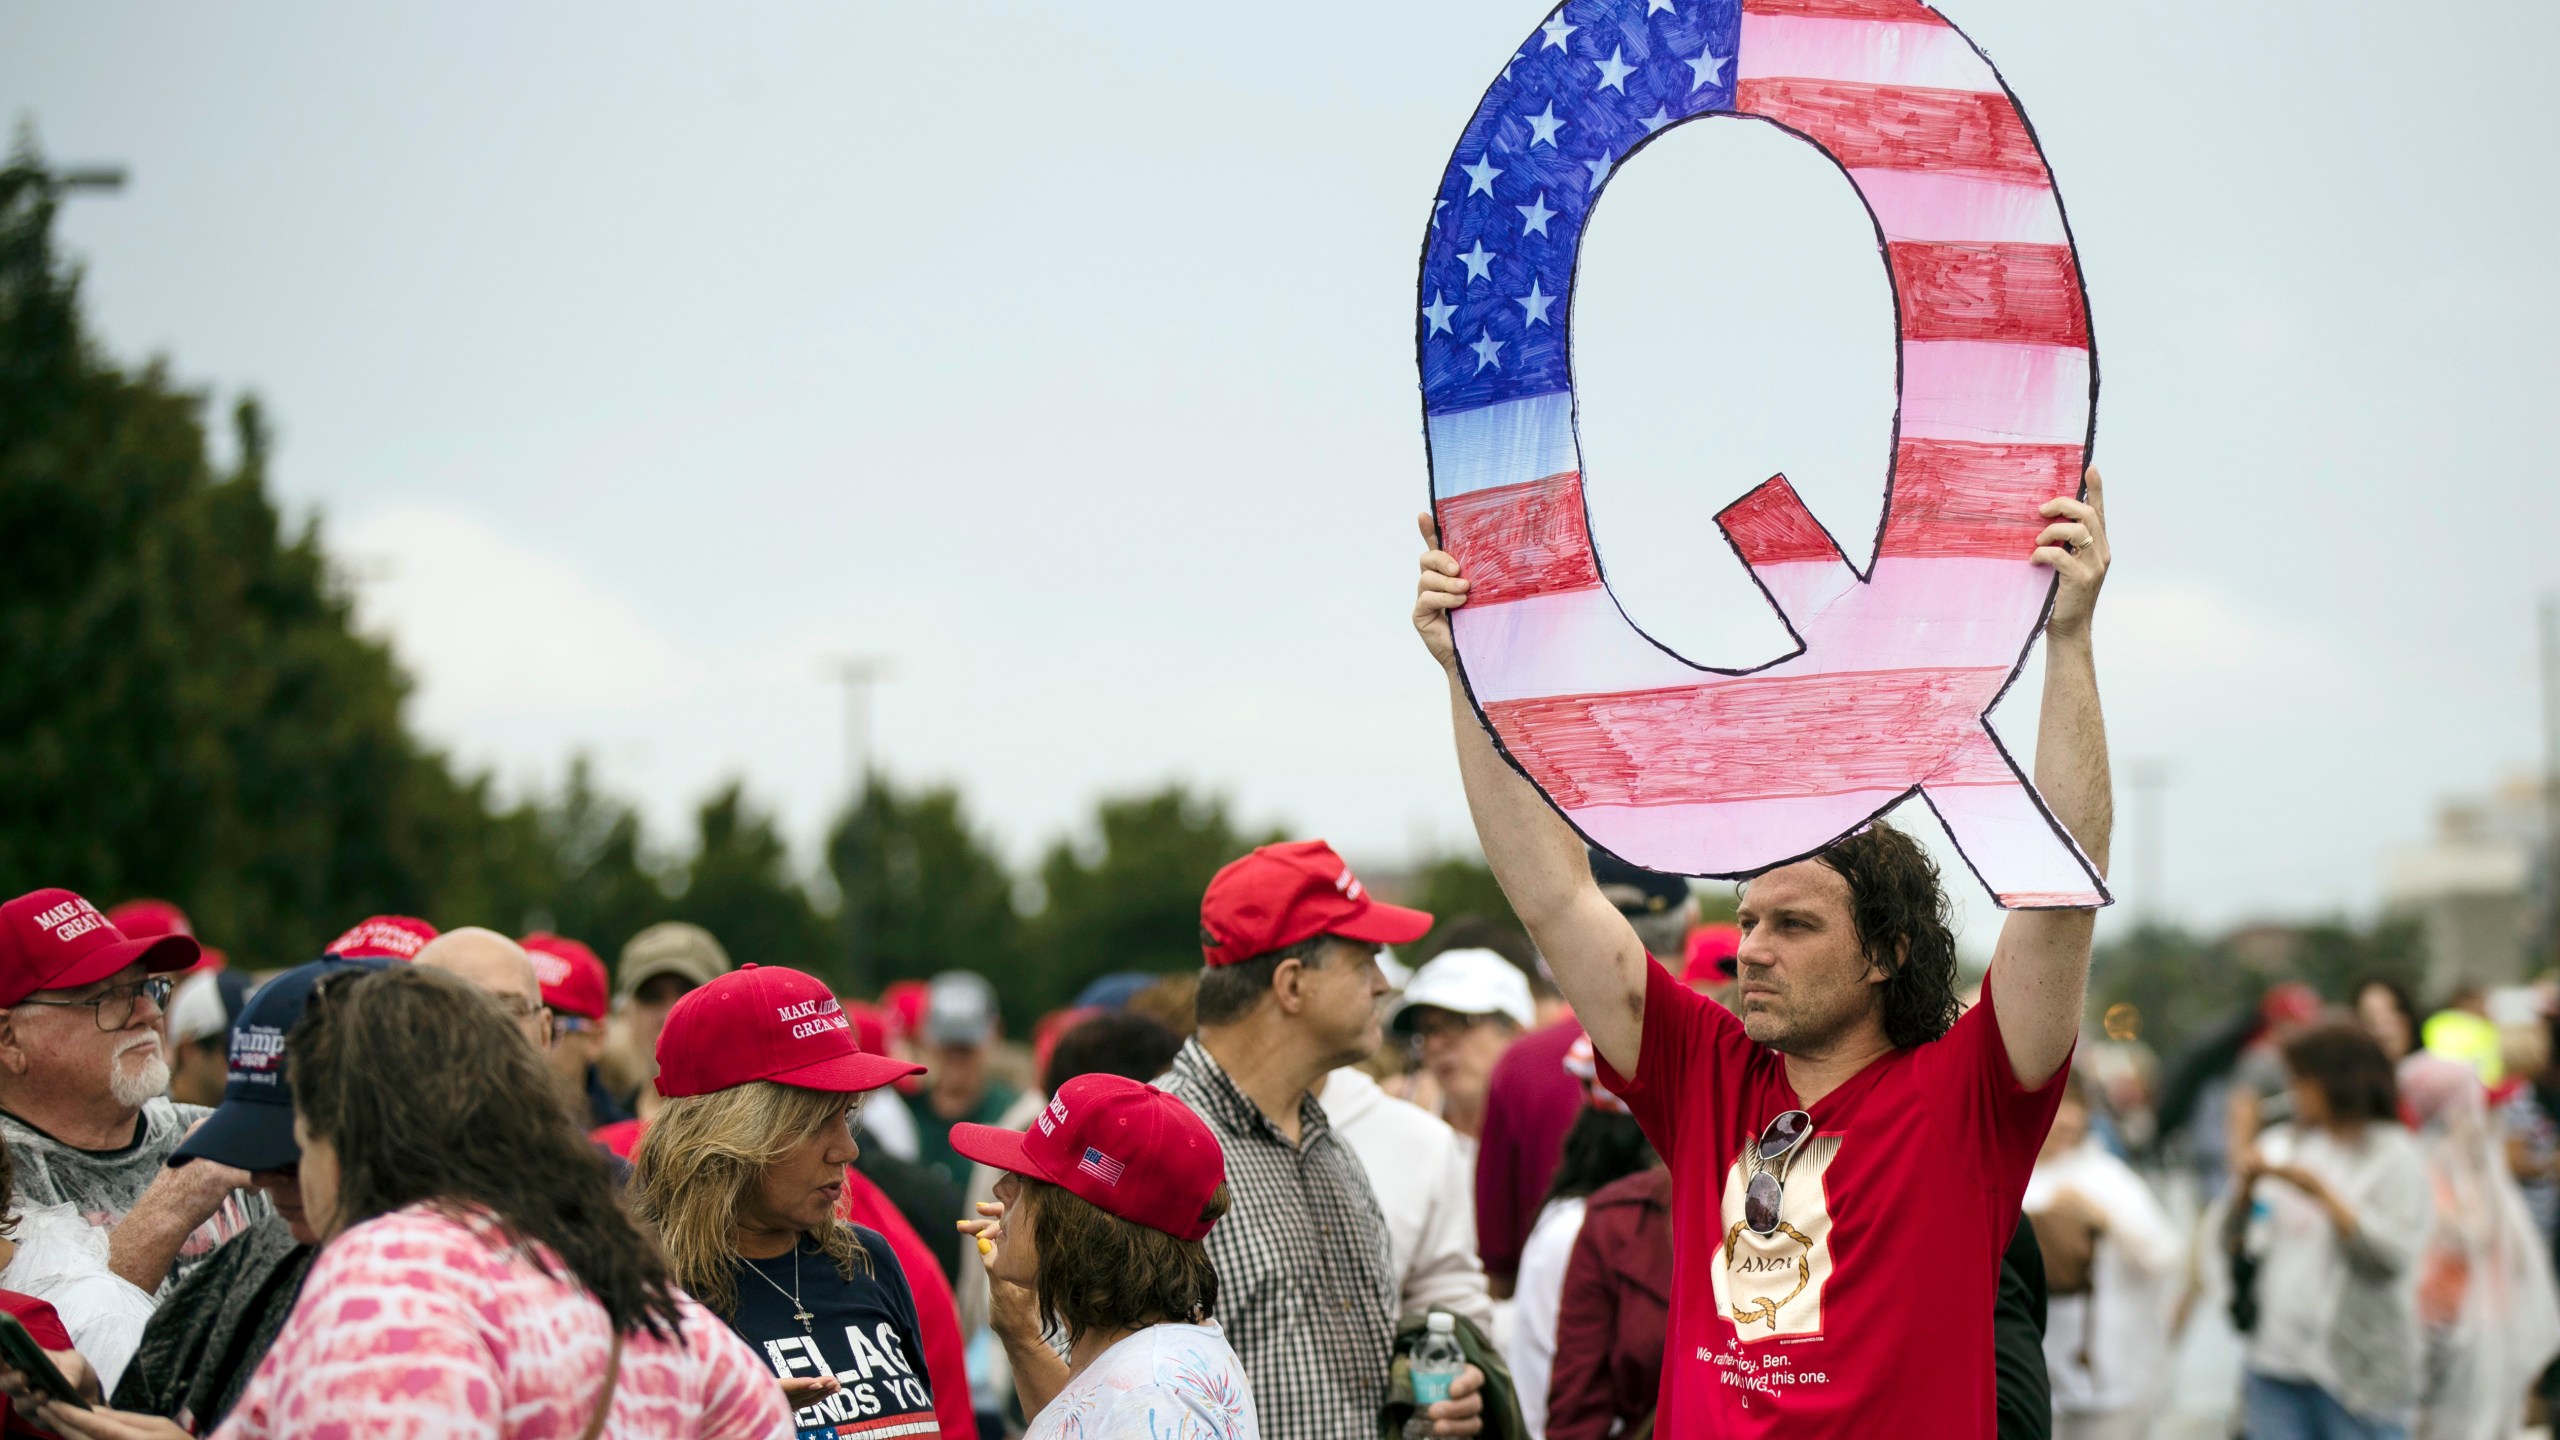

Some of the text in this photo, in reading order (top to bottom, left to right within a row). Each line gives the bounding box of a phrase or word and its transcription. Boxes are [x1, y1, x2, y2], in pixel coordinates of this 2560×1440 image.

[1416, 0, 2114, 911] Q
[33, 901, 80, 932] MAKE
[56, 913, 102, 942] GREAT
[792, 1017, 835, 1039] GREA
[1038, 1110, 1056, 1138] GAIN
[1696, 1346, 1713, 1362] We
[1771, 1371, 1796, 1386] this
[1799, 1371, 1830, 1384] one.
[1762, 1354, 1792, 1369] Ben.
